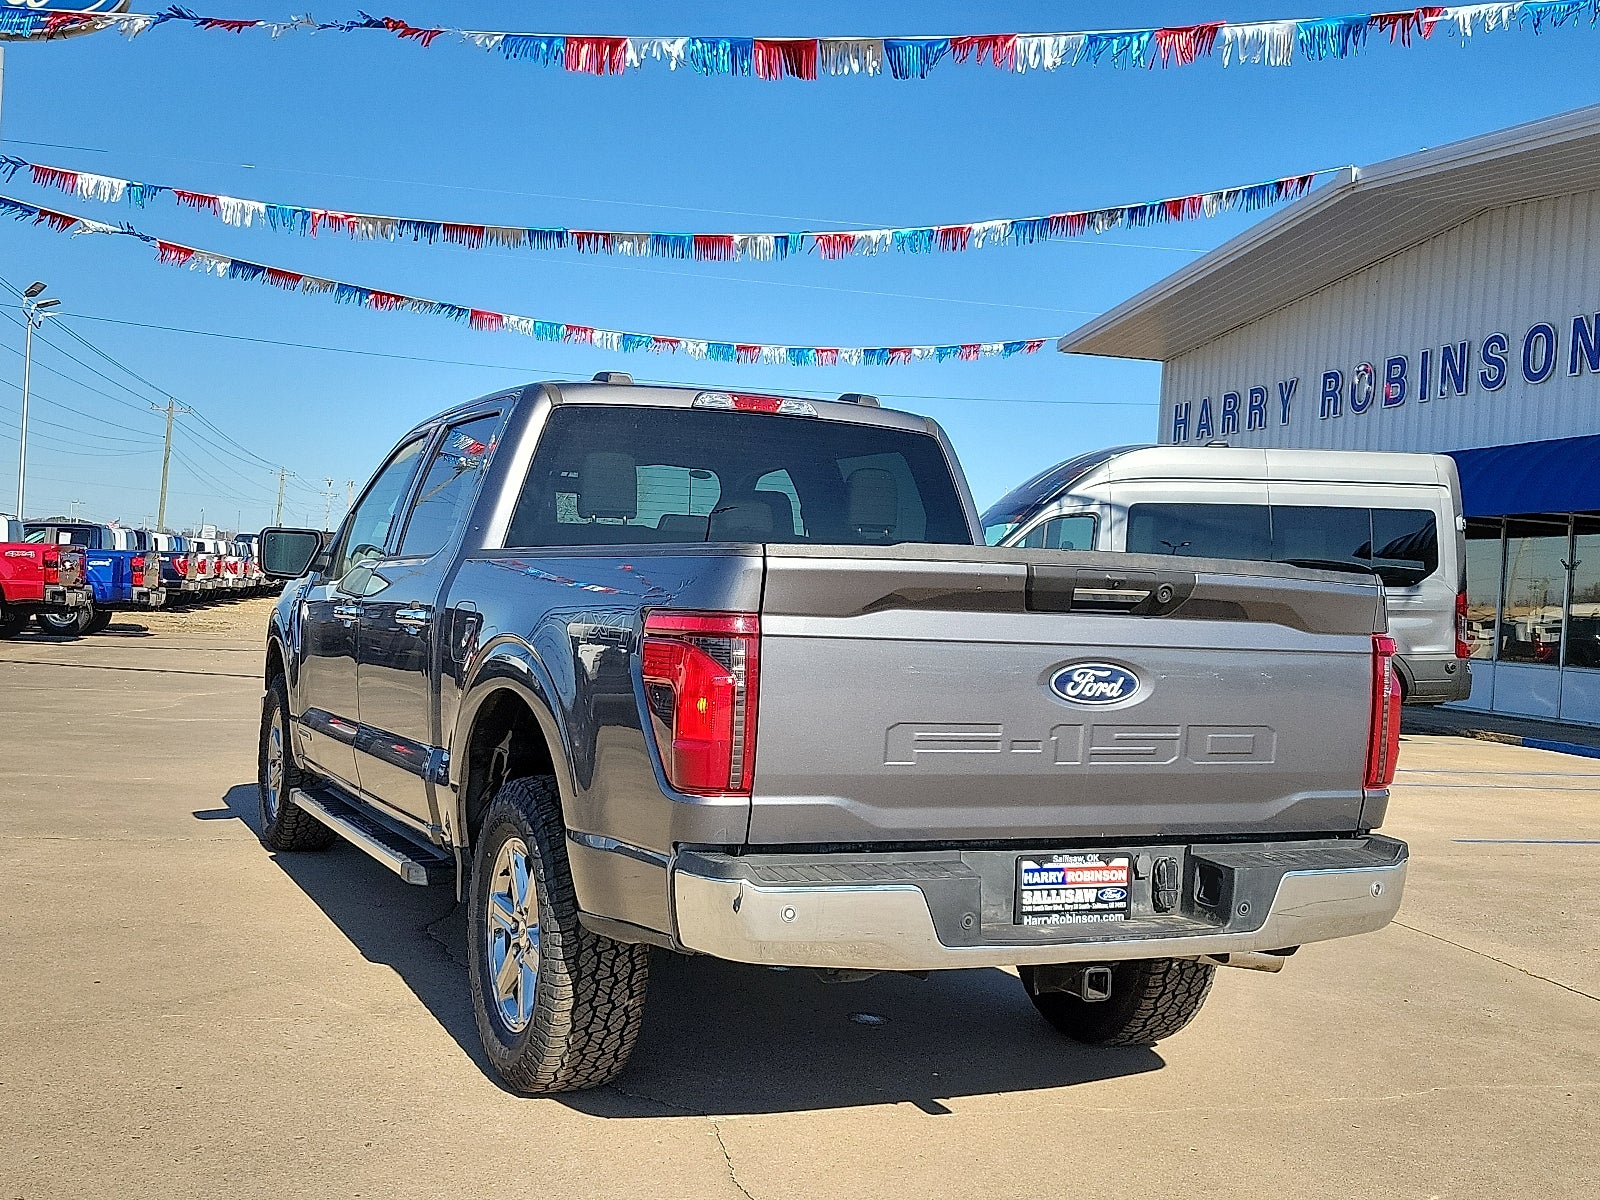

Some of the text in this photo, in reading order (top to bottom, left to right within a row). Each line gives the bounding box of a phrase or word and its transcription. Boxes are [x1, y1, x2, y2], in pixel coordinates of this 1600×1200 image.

[1171, 311, 1600, 444] HARRY ROBINSON
[1065, 667, 1124, 699] Ford
[884, 722, 1277, 766] F-150
[1086, 853, 1100, 863] OK
[1023, 869, 1128, 884] HARRY ROBINSON
[1022, 888, 1098, 905] SALLISAW
[1023, 913, 1125, 926] HarryRobinson.com
